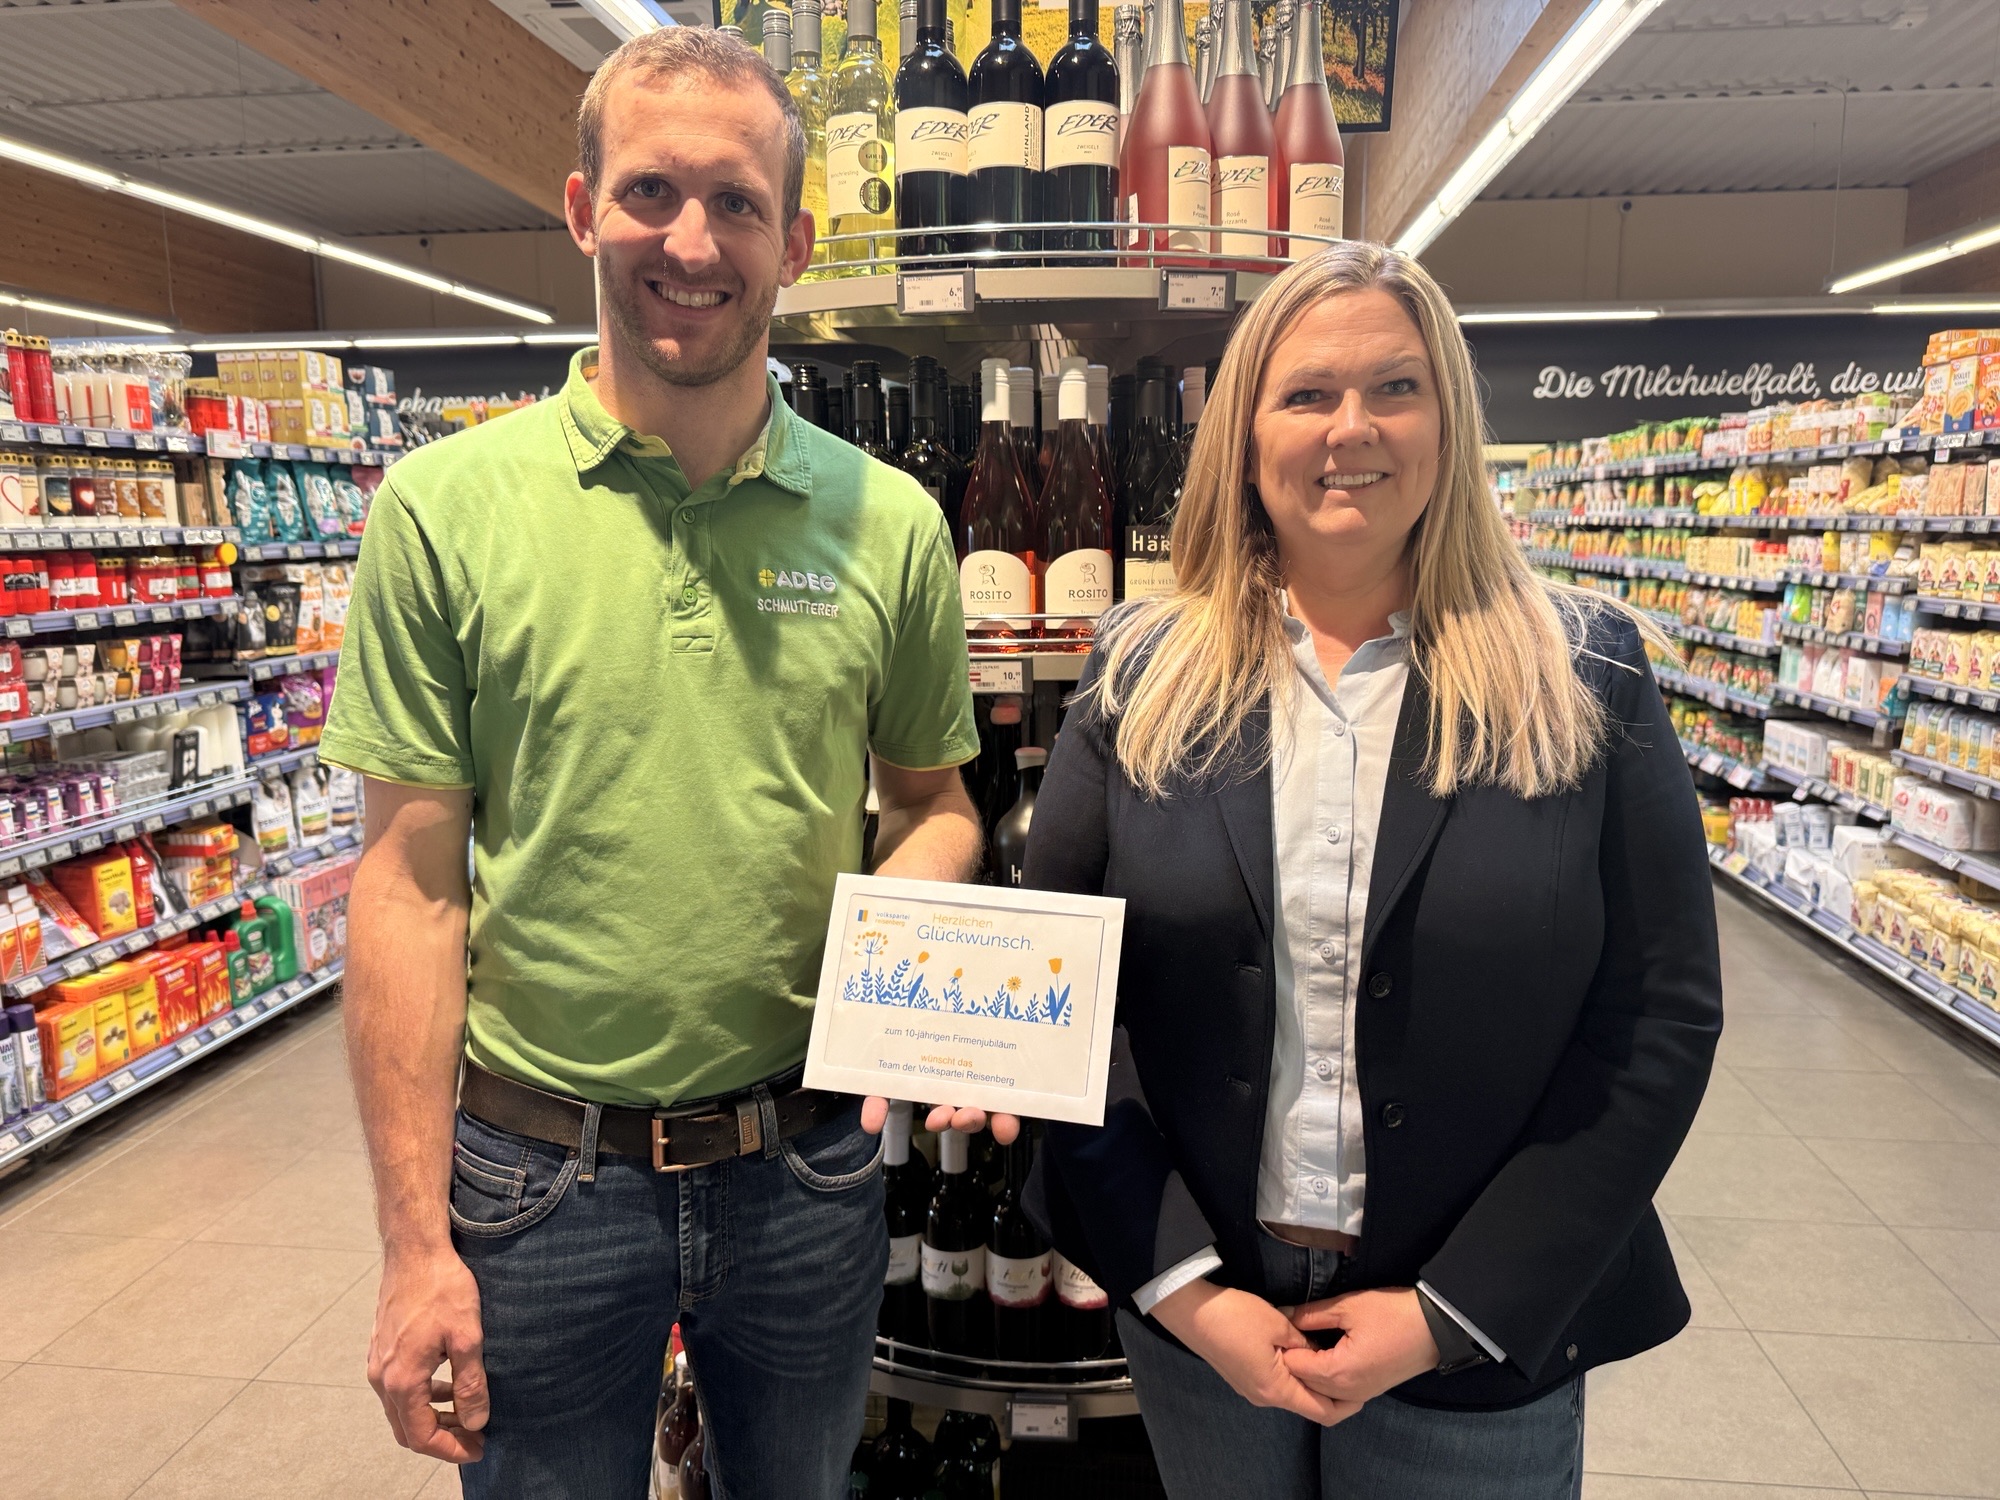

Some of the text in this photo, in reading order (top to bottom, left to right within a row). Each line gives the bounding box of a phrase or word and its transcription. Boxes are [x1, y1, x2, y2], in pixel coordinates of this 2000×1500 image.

[911, 120, 968, 140] EDER
[1057, 113, 1118, 136] EDER
[1023, 105, 1031, 168] WEINLAND
[1295, 176, 1342, 195] EDER
[1226, 210, 1241, 218] Rosé
[1318, 216, 1331, 224] Rosé
[1532, 365, 1595, 399] Die
[1600, 362, 1821, 405] Milchvielfalt,
[1829, 361, 1880, 394] die
[777, 570, 836, 594] ADEG
[970, 590, 1012, 600] ROSITO
[1068, 588, 1108, 599] ROSITO
[757, 598, 839, 618] SCHMUTTERER
[875, 918, 906, 928] reisenberg
[876, 911, 911, 921] volkspartei
[932, 913, 993, 929] Herzlichen
[917, 924, 1035, 951] Glückwunsch.
[884, 1027, 1017, 1050] zum 10-jährigen Firmenjubiläum
[920, 1053, 974, 1068] wünscht das
[878, 1059, 1016, 1087] Team der Volkspartei Reisenberg
